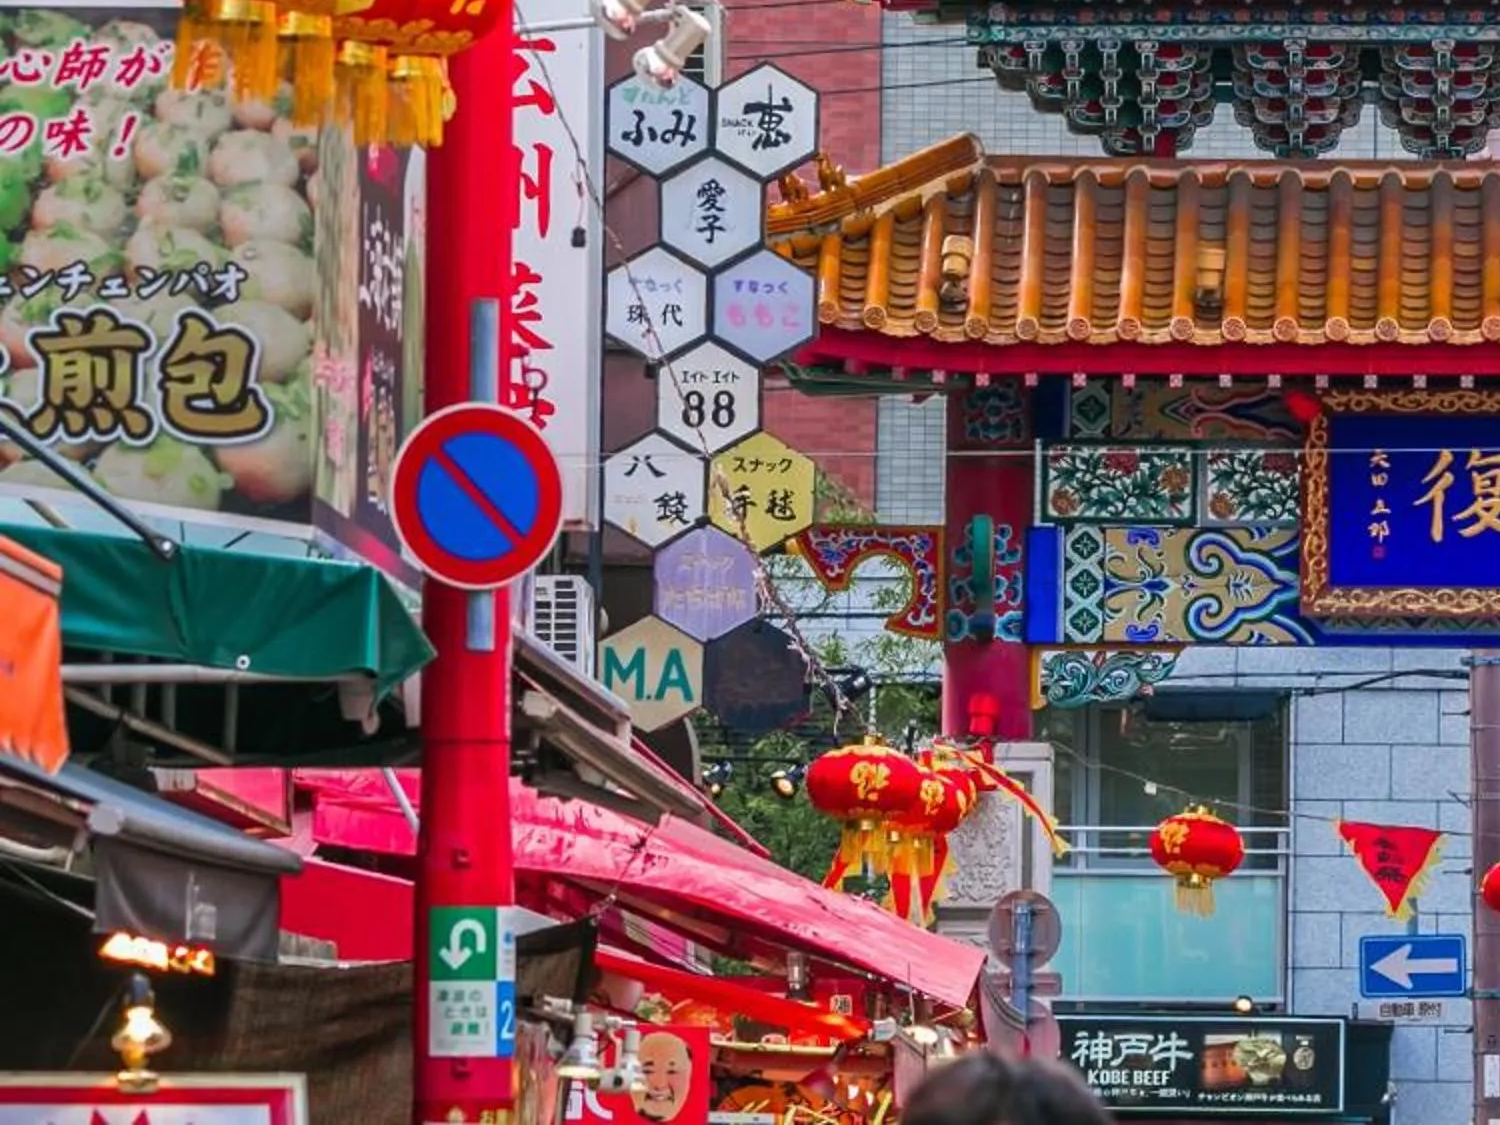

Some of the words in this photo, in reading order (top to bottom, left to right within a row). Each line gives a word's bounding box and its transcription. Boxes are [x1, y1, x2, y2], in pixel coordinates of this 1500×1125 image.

[621, 109, 697, 148] ふみ
[696, 178, 726, 244] 愛子
[733, 279, 789, 294] すなっく
[0, 307, 273, 441] 煎包
[682, 390, 735, 428] 88
[732, 457, 792, 474] スナック
[1071, 1031, 1195, 1071] 神戸牛
[1087, 1070, 1129, 1085] KOBE
[1133, 1070, 1172, 1085] BEEF
